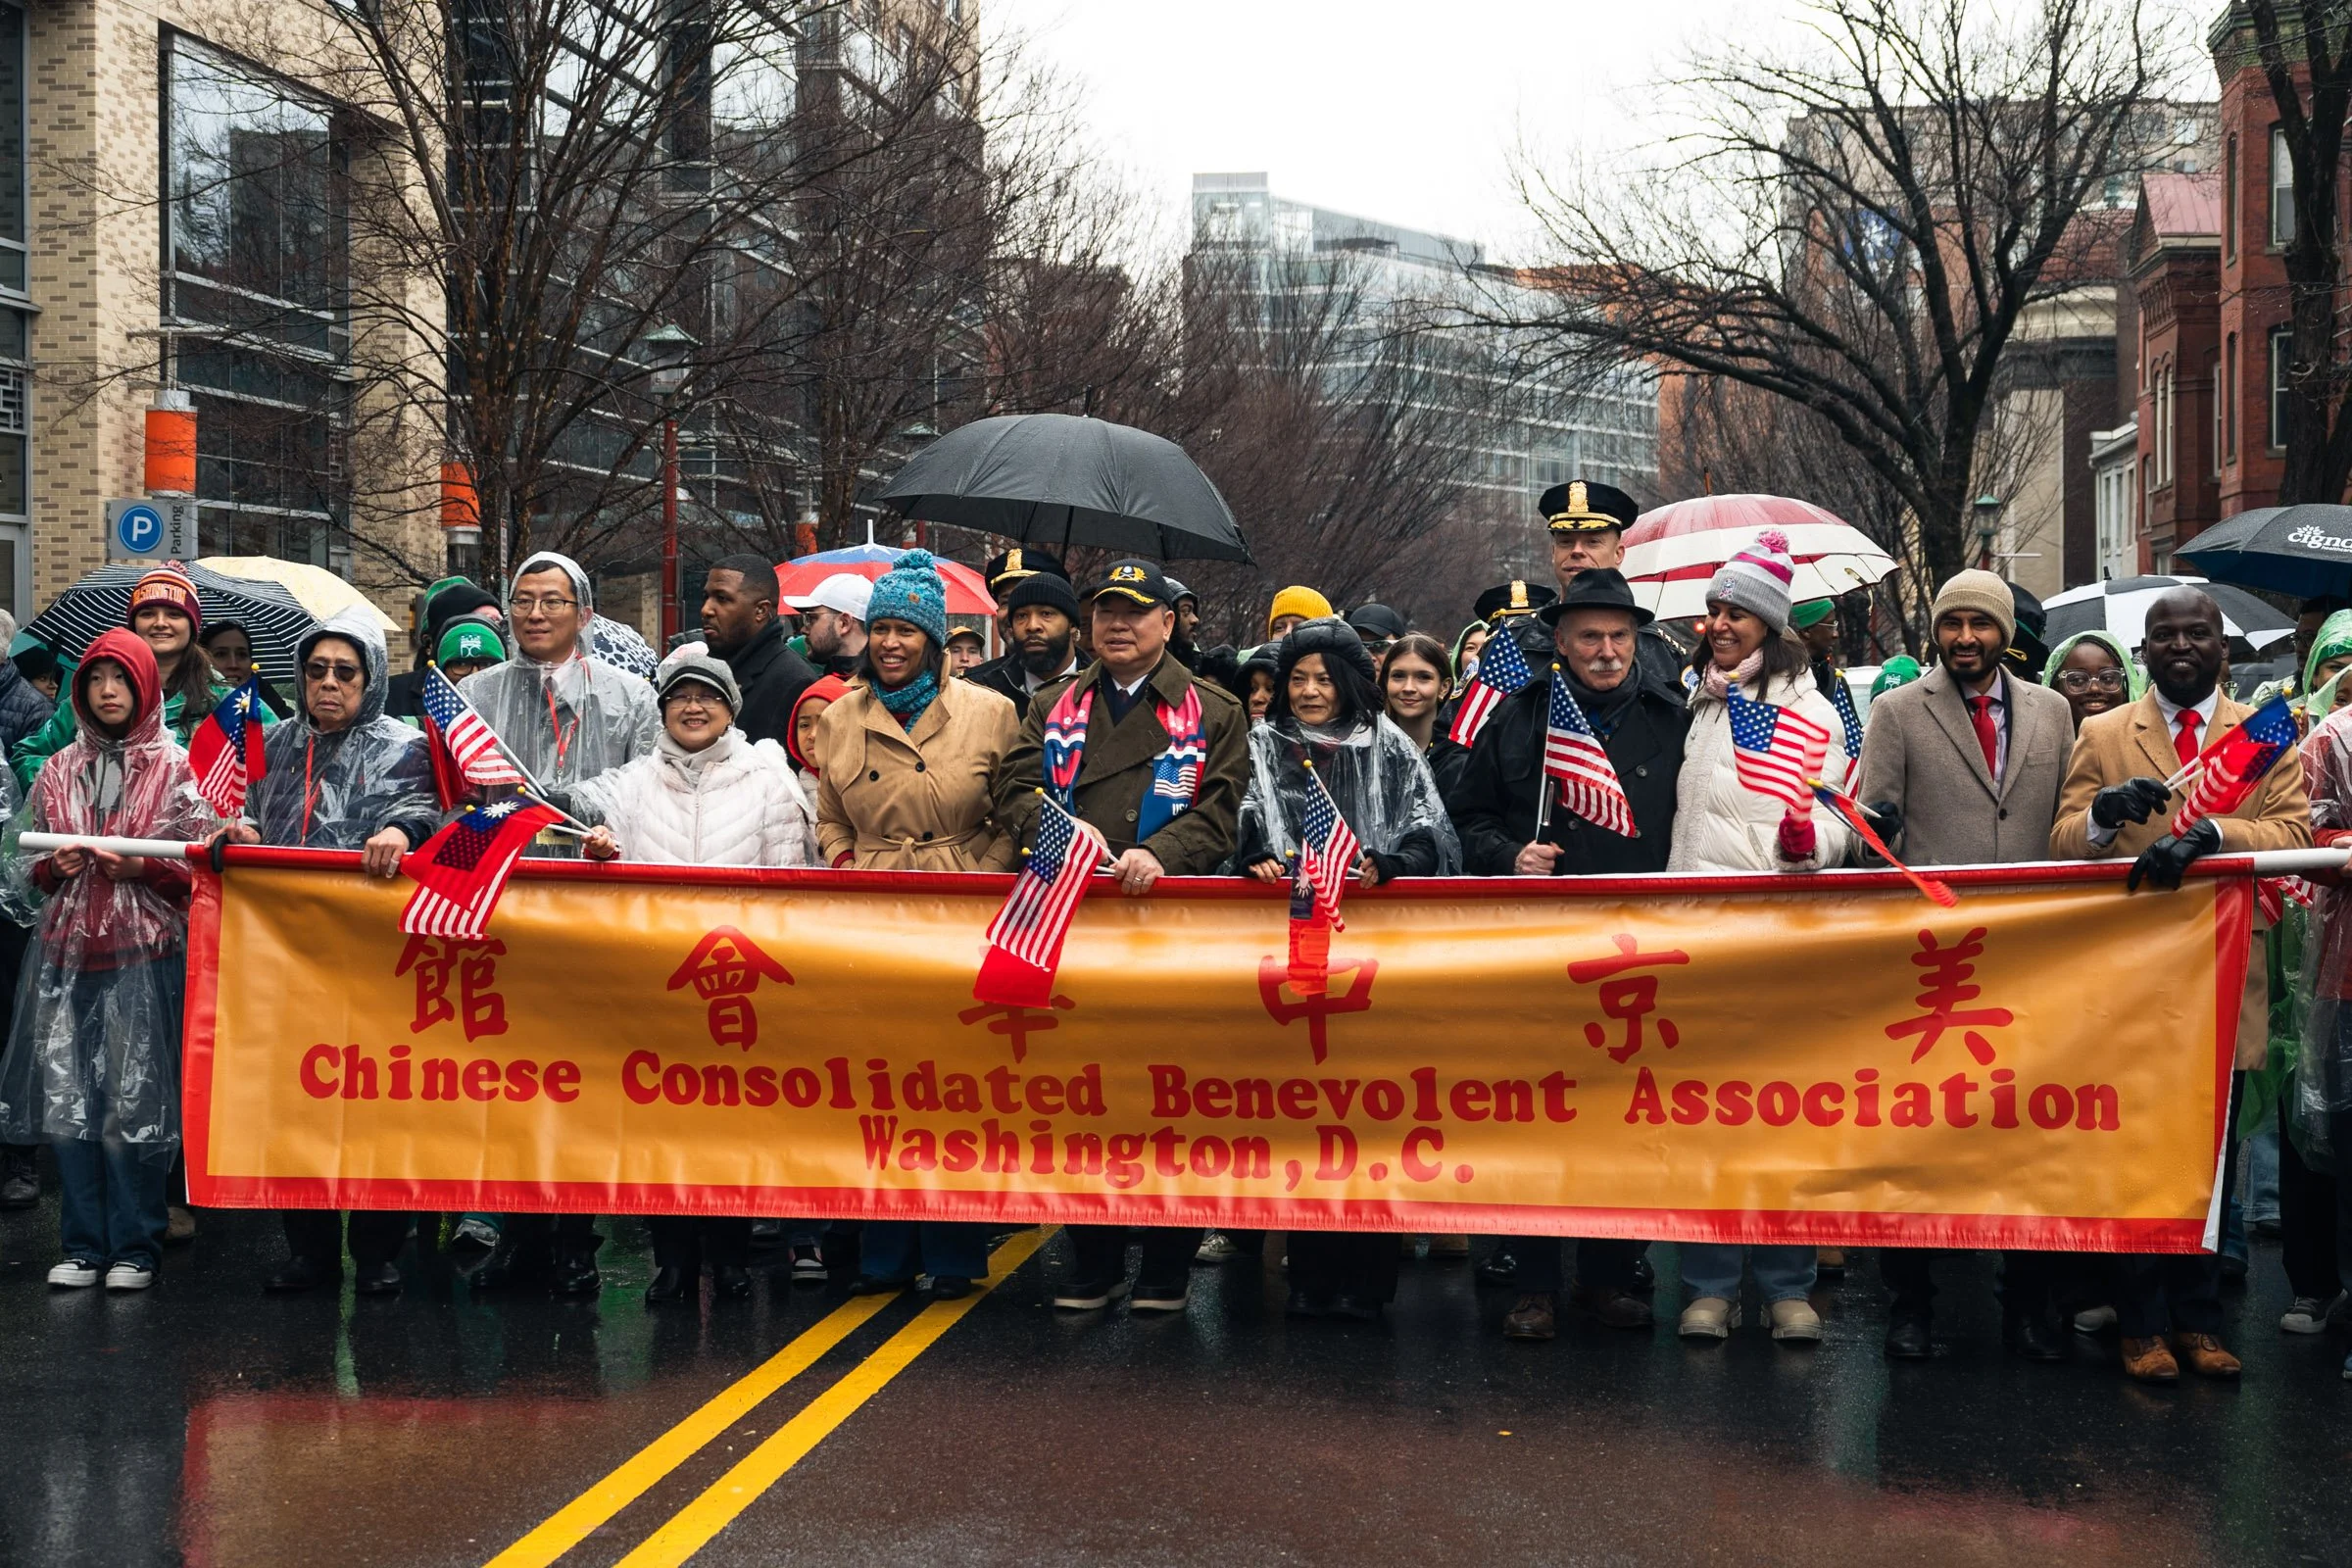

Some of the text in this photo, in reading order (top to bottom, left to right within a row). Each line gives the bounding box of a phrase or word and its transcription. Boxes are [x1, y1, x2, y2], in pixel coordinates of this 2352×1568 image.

[131, 515, 153, 542] P
[170, 505, 184, 555] Parking
[300, 1045, 2119, 1131] Chinese Consolidated Benevolent Association
